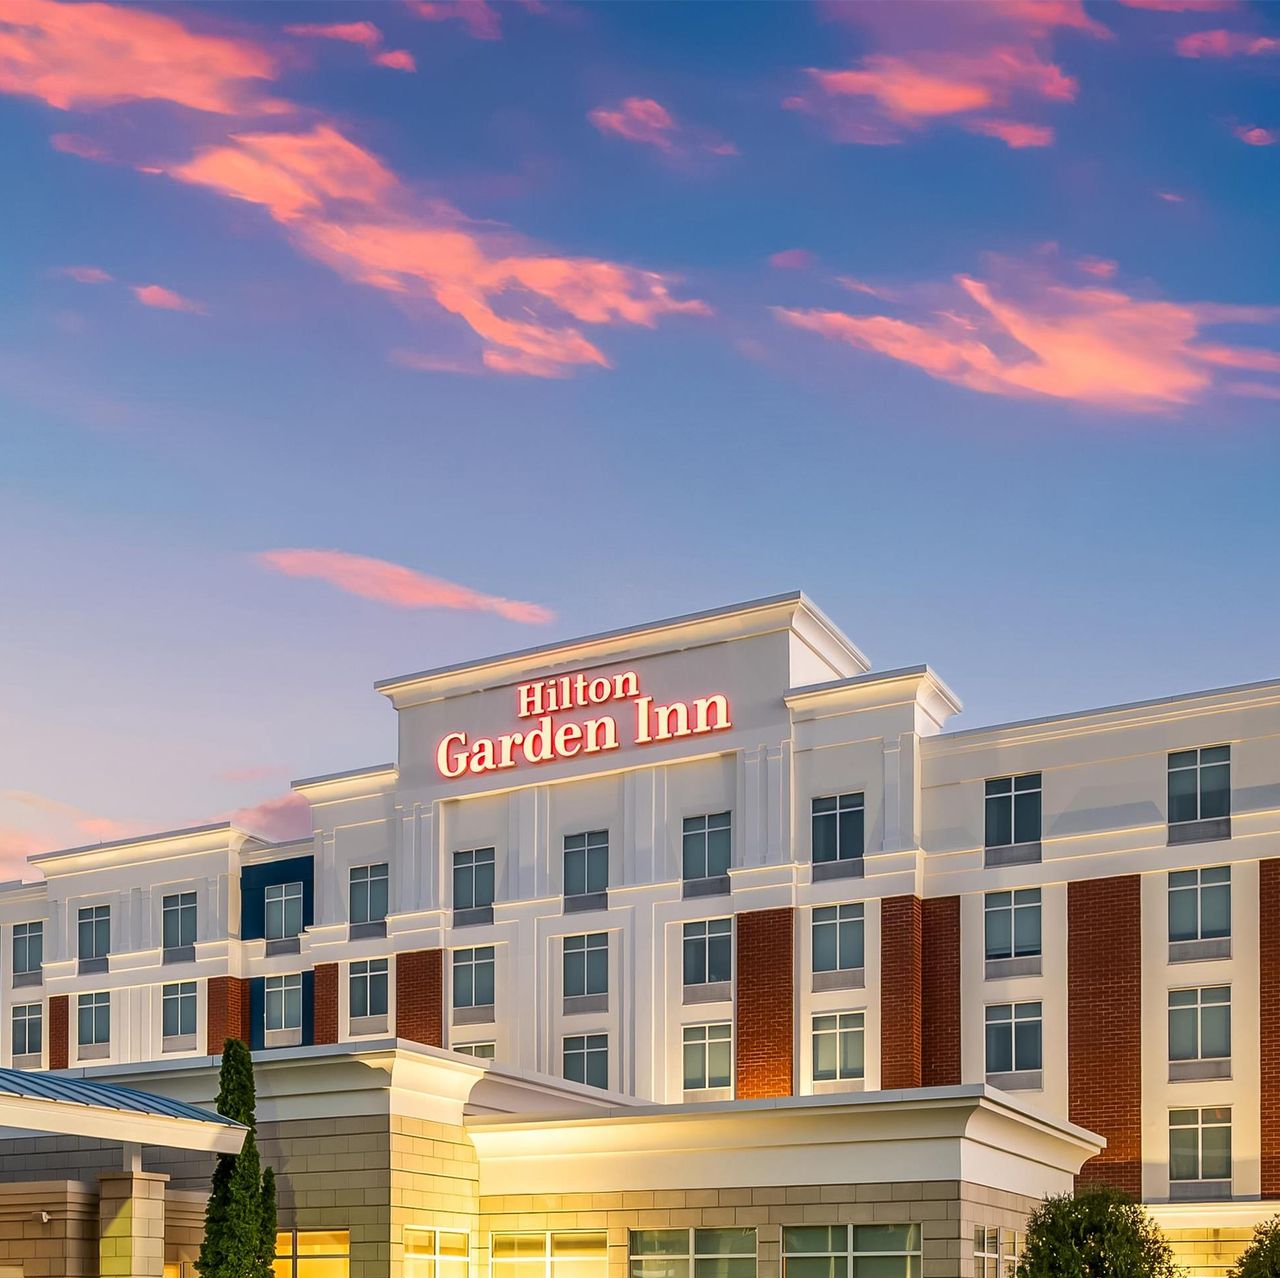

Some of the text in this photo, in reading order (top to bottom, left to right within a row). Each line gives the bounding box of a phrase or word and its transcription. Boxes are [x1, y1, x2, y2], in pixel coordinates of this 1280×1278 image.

[517, 669, 640, 718] Hilton
[436, 694, 732, 778] Garden Inn
